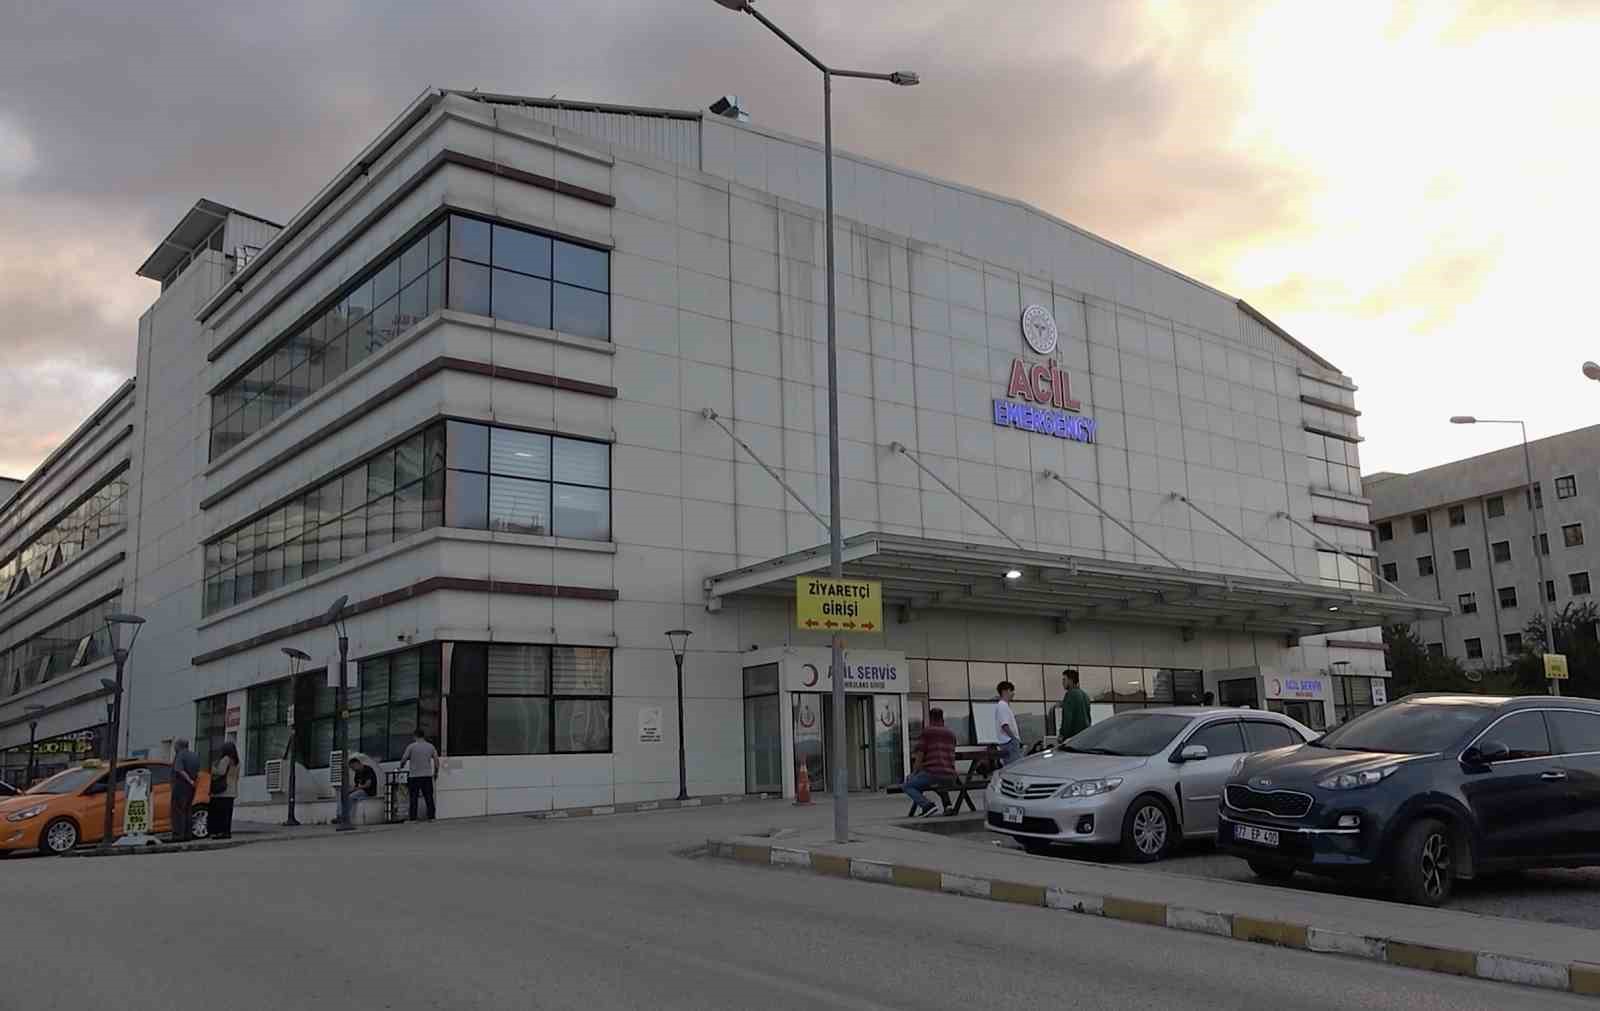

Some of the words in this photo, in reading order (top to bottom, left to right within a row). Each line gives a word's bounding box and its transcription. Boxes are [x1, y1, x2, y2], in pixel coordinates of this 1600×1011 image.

[1008, 357, 1081, 412] ACİL
[993, 400, 1096, 443] EMERGENCY
[809, 580, 870, 598] ZİYARETÇİ
[823, 600, 858, 617] GİRİŞİ
[857, 664, 897, 681] SERVİS
